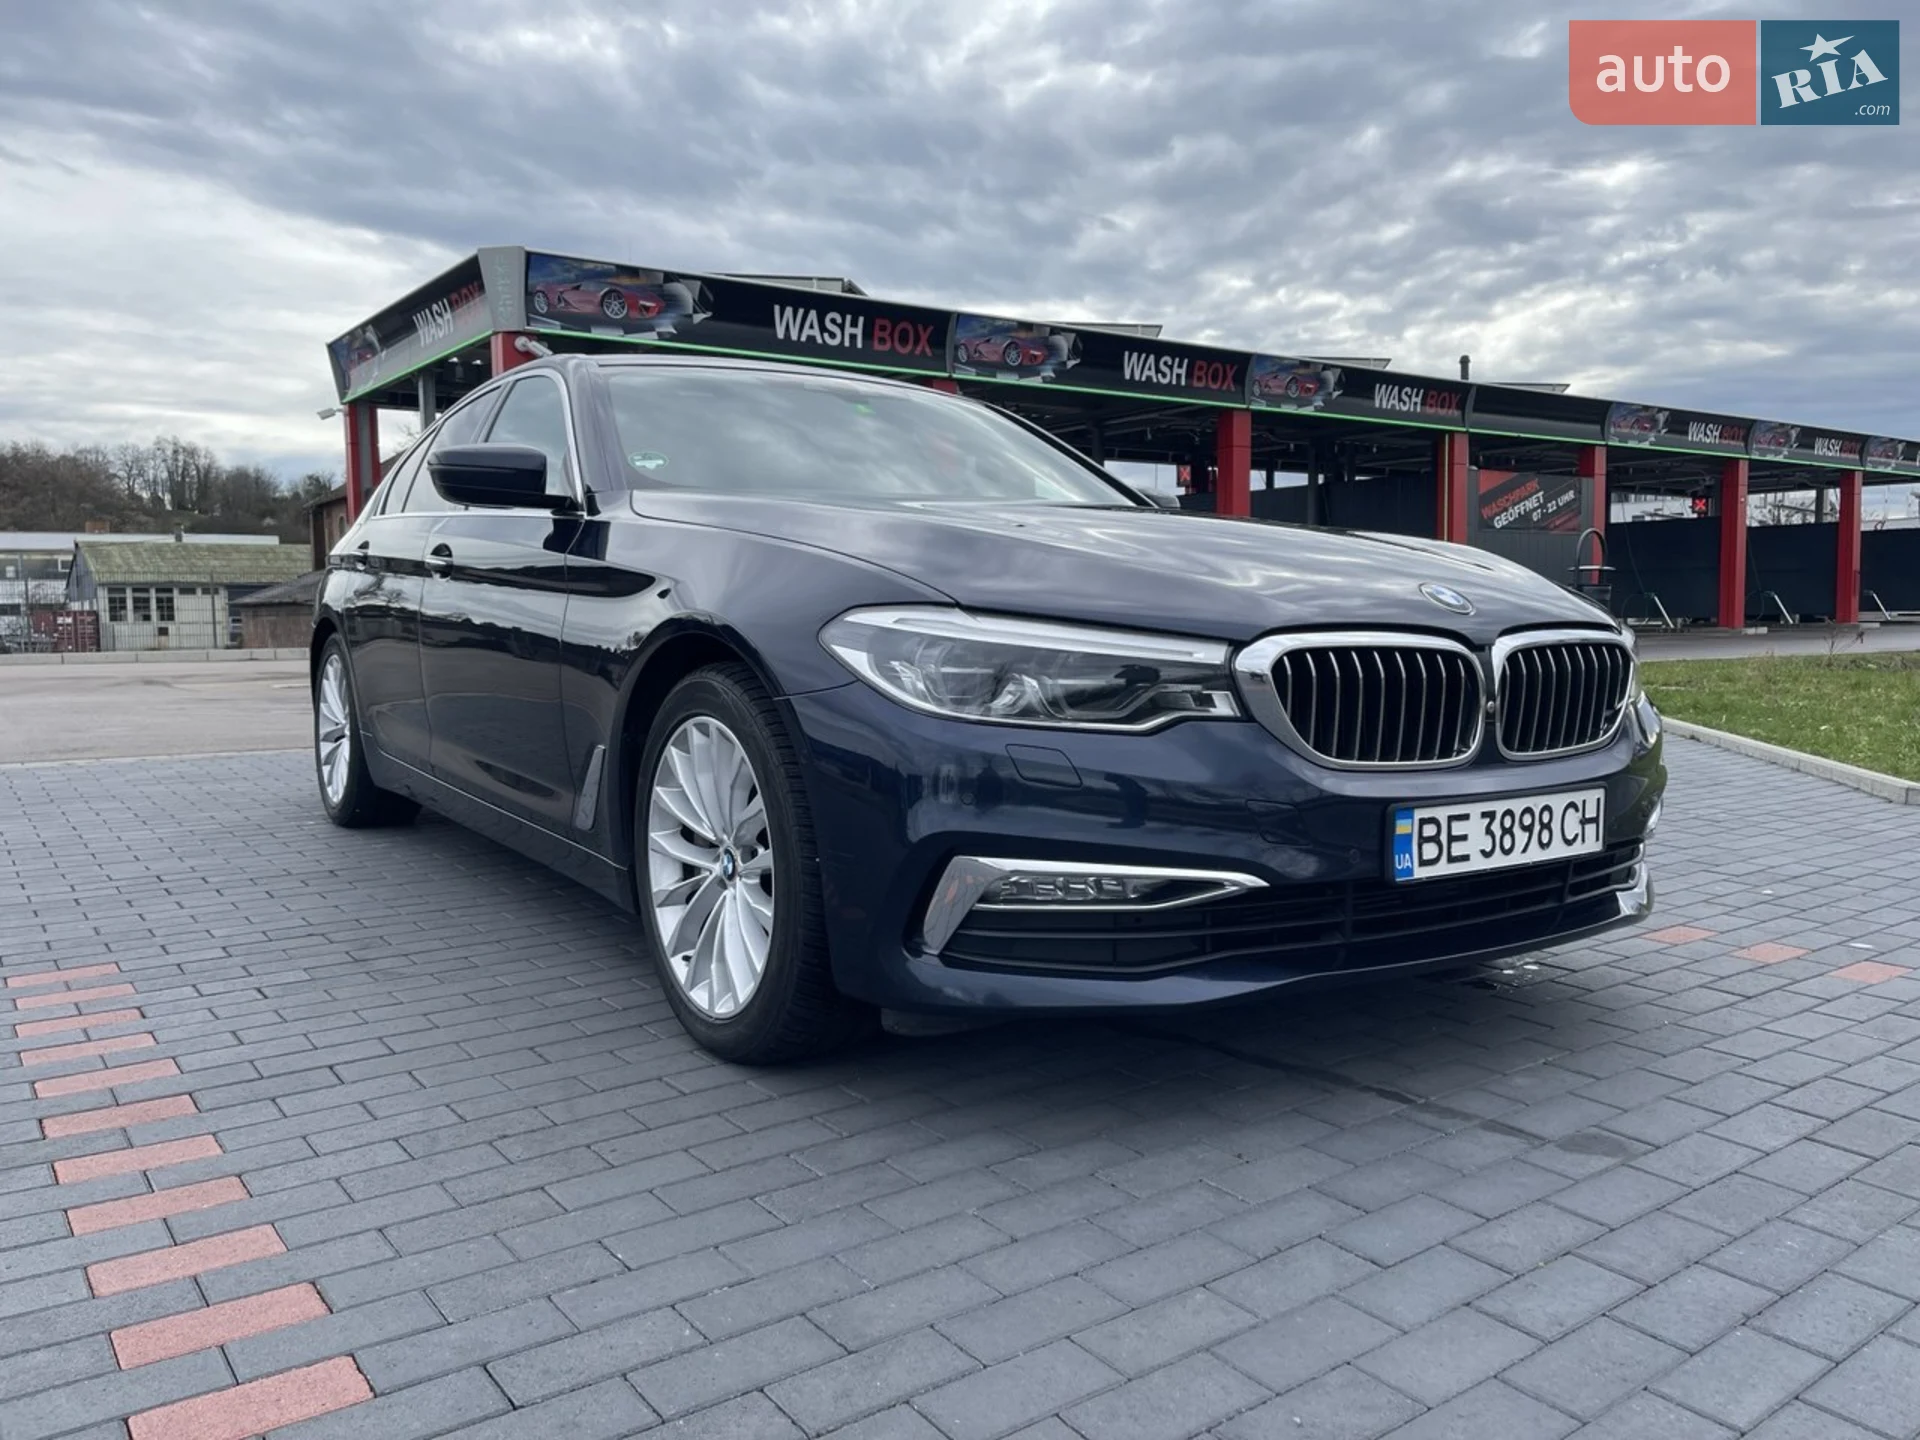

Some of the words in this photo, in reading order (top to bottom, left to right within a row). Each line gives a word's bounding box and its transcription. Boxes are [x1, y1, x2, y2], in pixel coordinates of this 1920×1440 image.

[412, 298, 454, 348] WASH
[773, 304, 865, 348] WASH
[872, 318, 934, 357] BOX
[1123, 351, 1188, 386] WASH
[1192, 360, 1237, 392] BOX
[1374, 383, 1424, 413] WASH
[1426, 390, 1460, 417] BOX
[1688, 421, 1722, 444] WASH
[1814, 436, 1842, 456] WASH
[1493, 491, 1544, 529] GEÖFFNET
[1532, 508, 1542, 522] 07
[1557, 489, 1575, 507] UHR
[1417, 813, 1471, 867] BE
[1479, 804, 1554, 859] 3898
[1560, 797, 1601, 846] CH
[1395, 853, 1412, 869] UA
